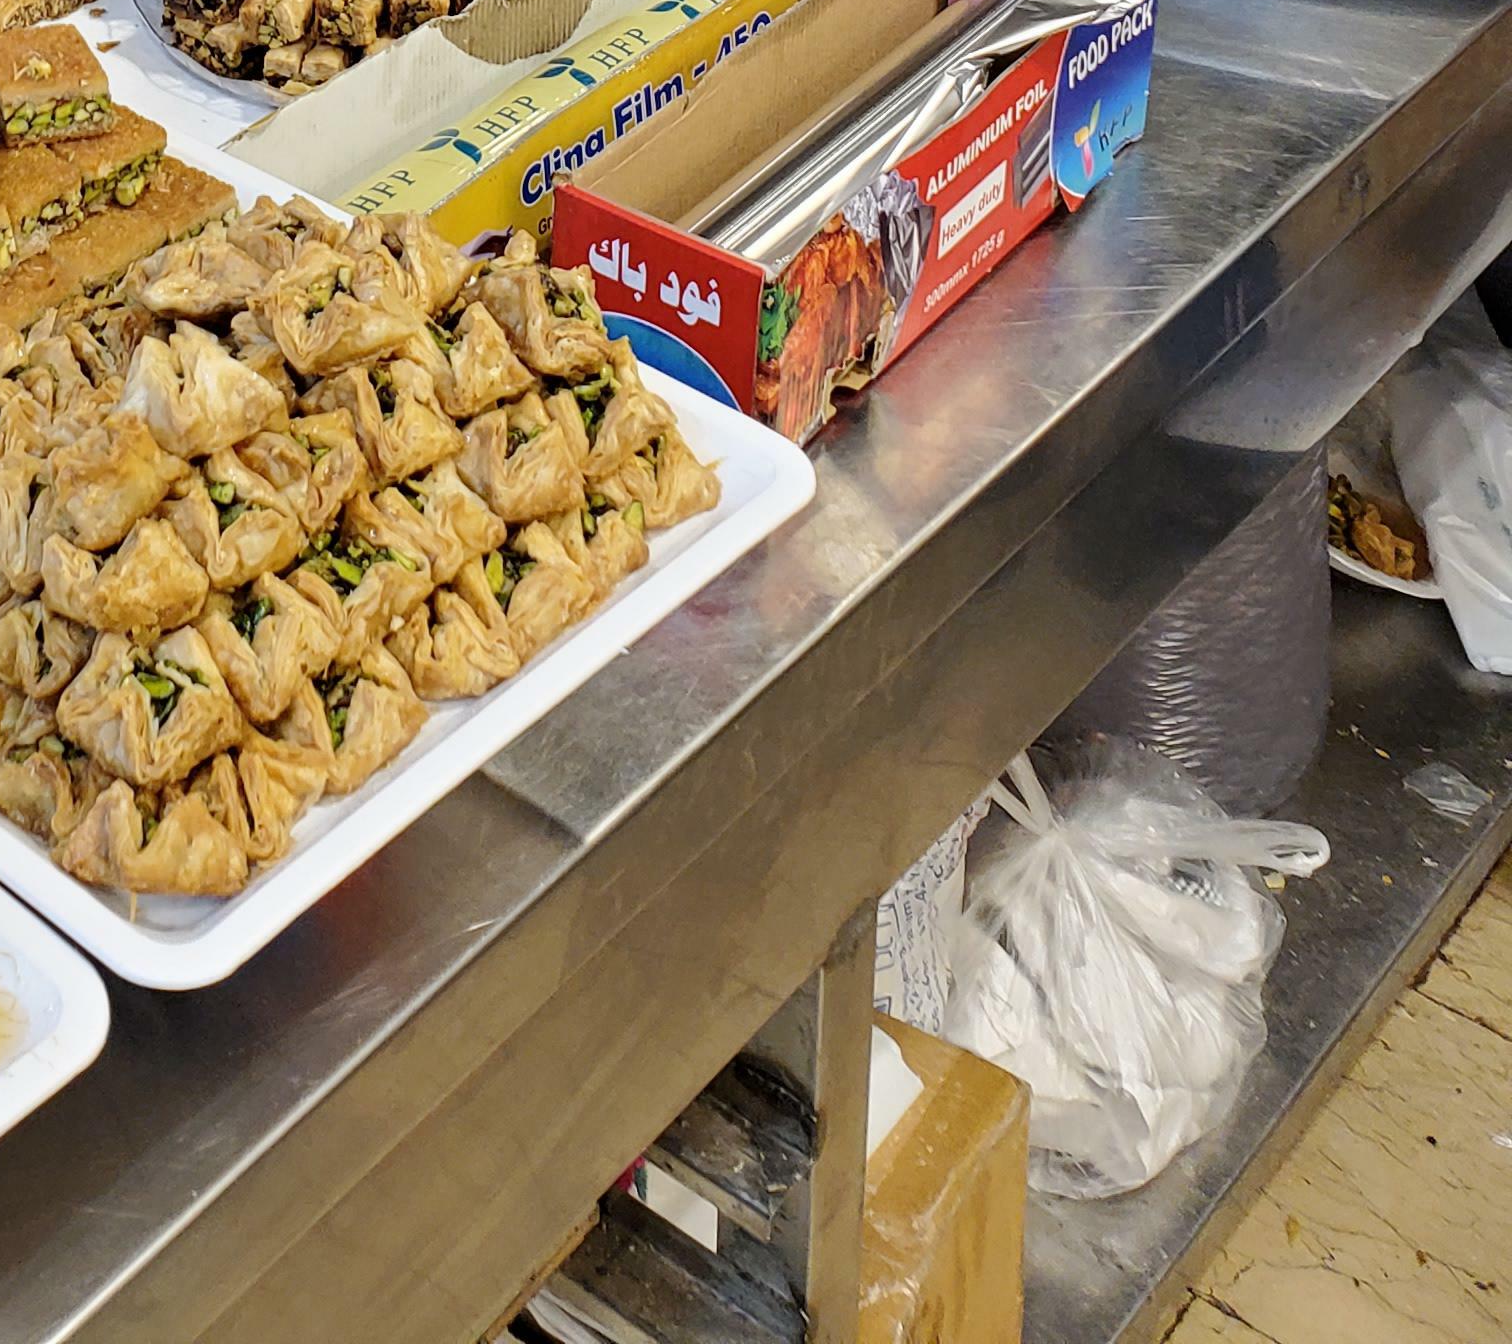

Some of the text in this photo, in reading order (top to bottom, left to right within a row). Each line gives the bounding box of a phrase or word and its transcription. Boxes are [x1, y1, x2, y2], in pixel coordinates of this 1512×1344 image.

[1067, 32, 1109, 92] FOOD
[346, 167, 417, 214] HFP
[472, 93, 542, 141] HFP
[587, 26, 651, 72] HFP
[613, 73, 684, 138] Film
[925, 78, 1049, 202] ALUMINIUM FOIL
[941, 178, 1006, 247] Heavy duty
[658, 270, 721, 328] فود
